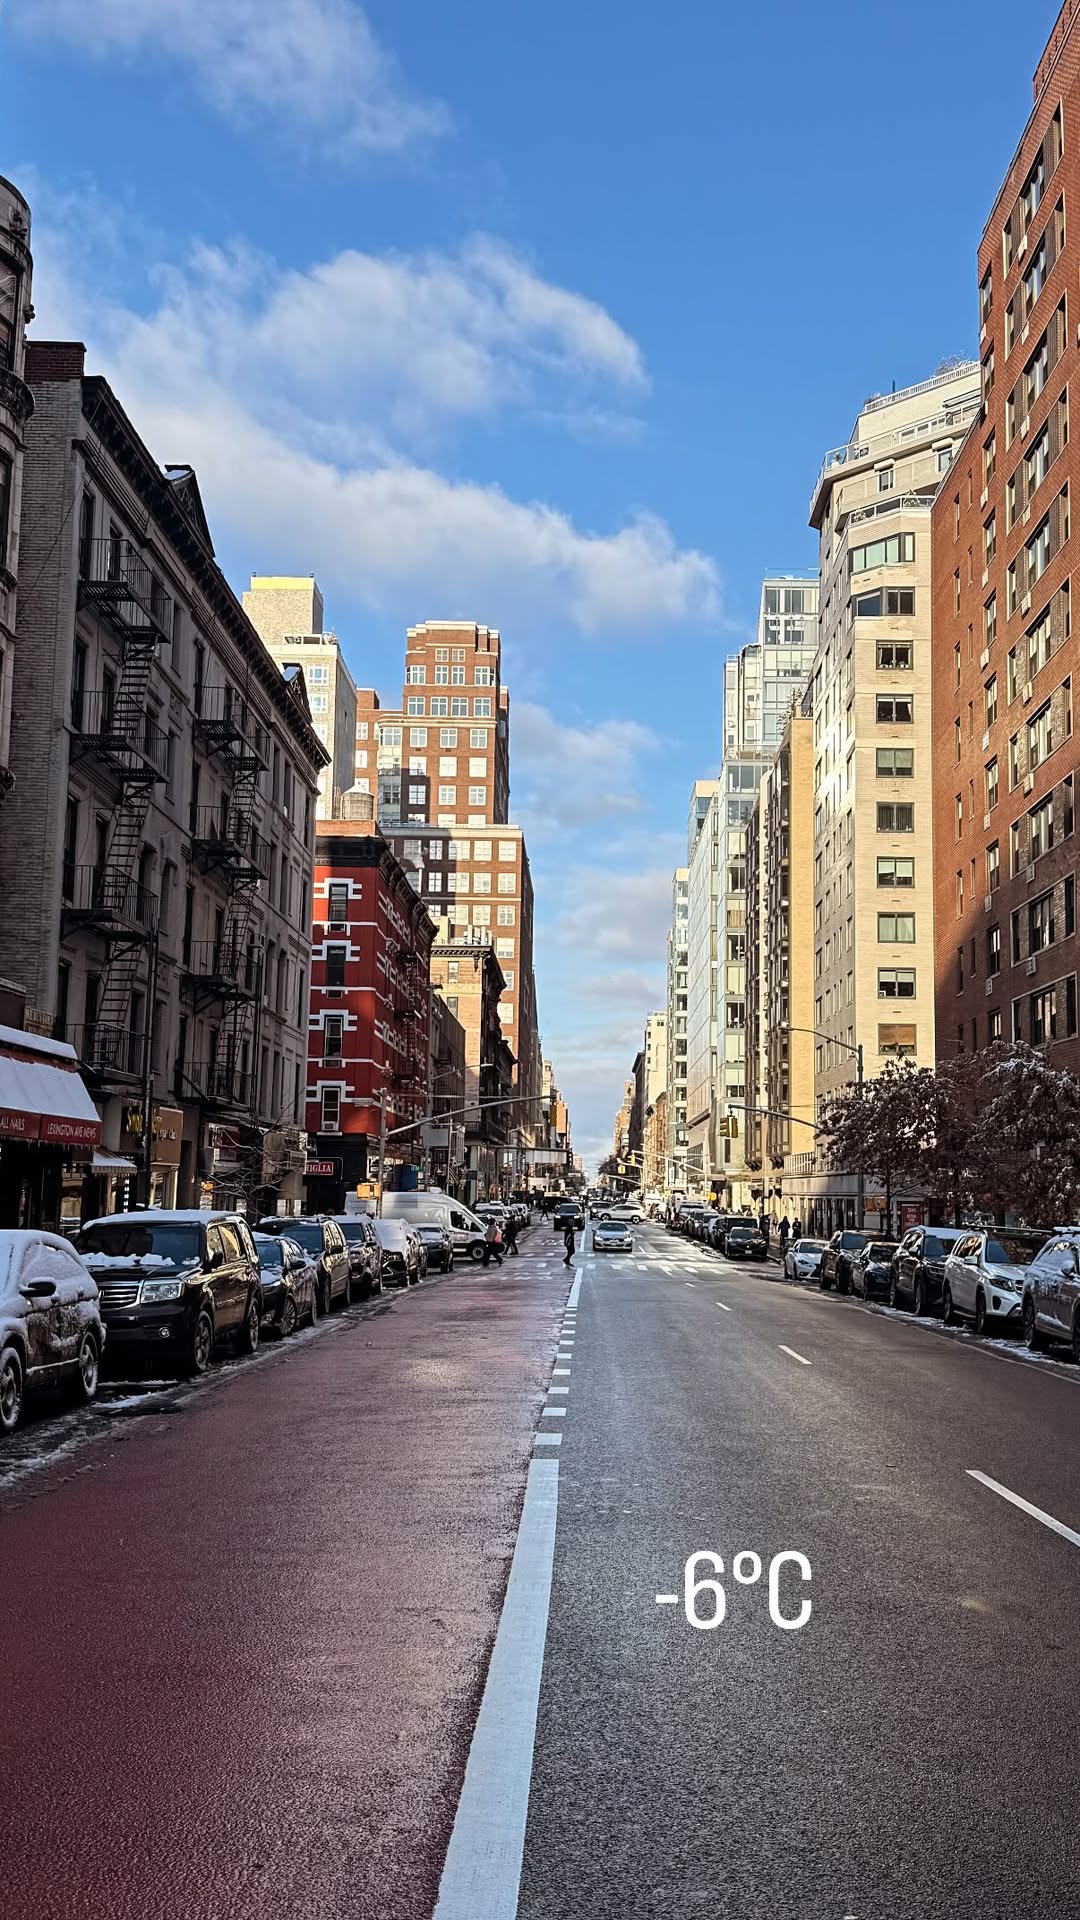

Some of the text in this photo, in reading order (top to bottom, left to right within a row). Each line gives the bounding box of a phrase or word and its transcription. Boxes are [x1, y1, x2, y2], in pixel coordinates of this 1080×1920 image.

[10, 1117, 25, 1131] NAILS
[47, 1123, 74, 1136] LEXINGTON
[83, 1127, 96, 1139] NEWS
